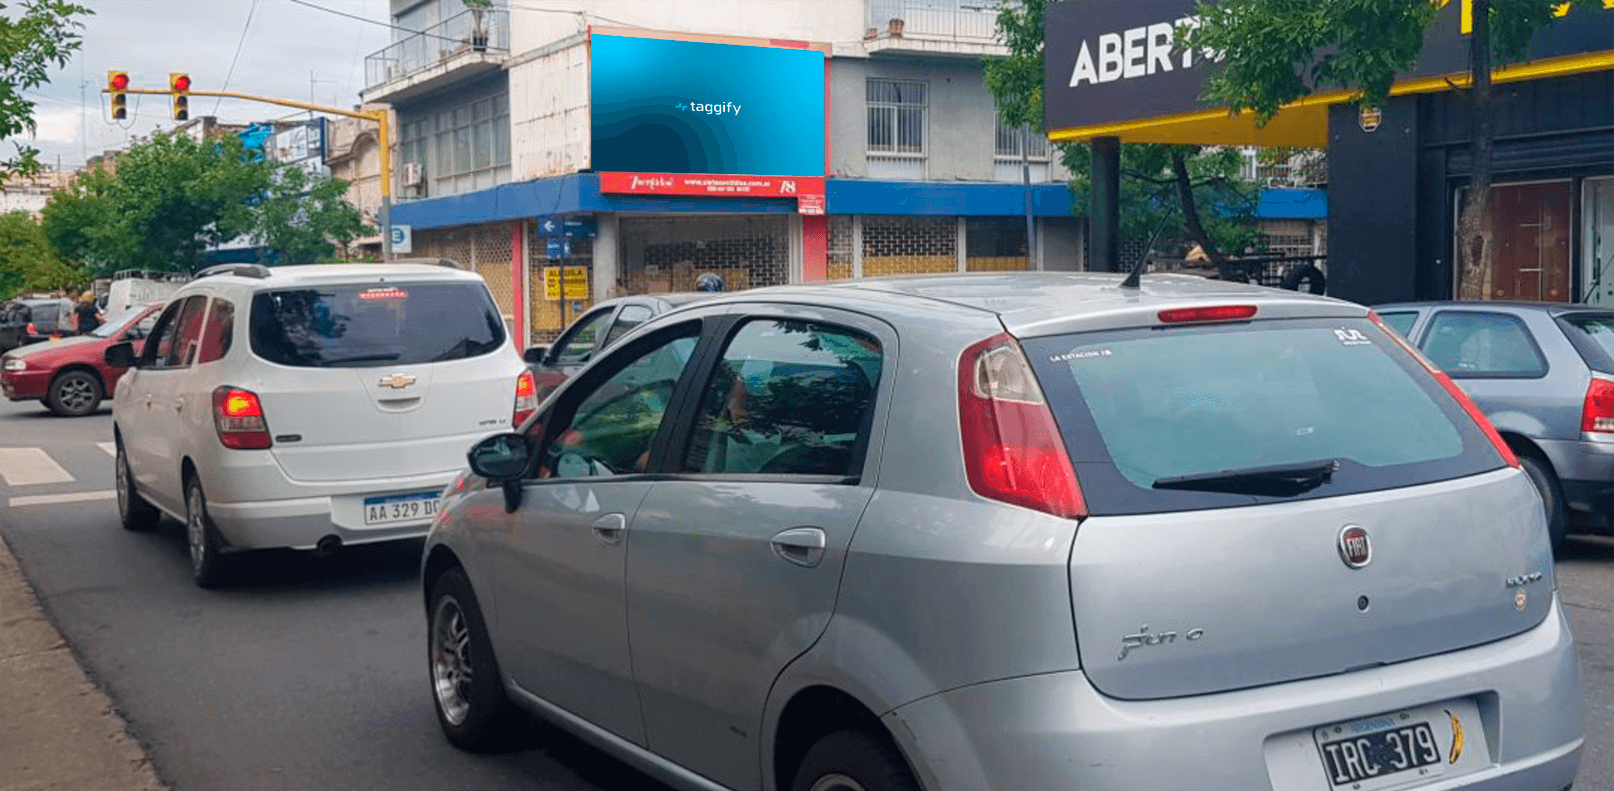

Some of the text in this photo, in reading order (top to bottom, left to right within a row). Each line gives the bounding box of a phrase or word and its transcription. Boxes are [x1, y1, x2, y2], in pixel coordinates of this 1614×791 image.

[1069, 14, 1228, 88] ABERT
[690, 101, 741, 115] taggify
[369, 506, 387, 521] AA
[392, 502, 419, 518] 329
[1346, 537, 1366, 557] FIAT
[1326, 725, 1437, 783] IRC 379
